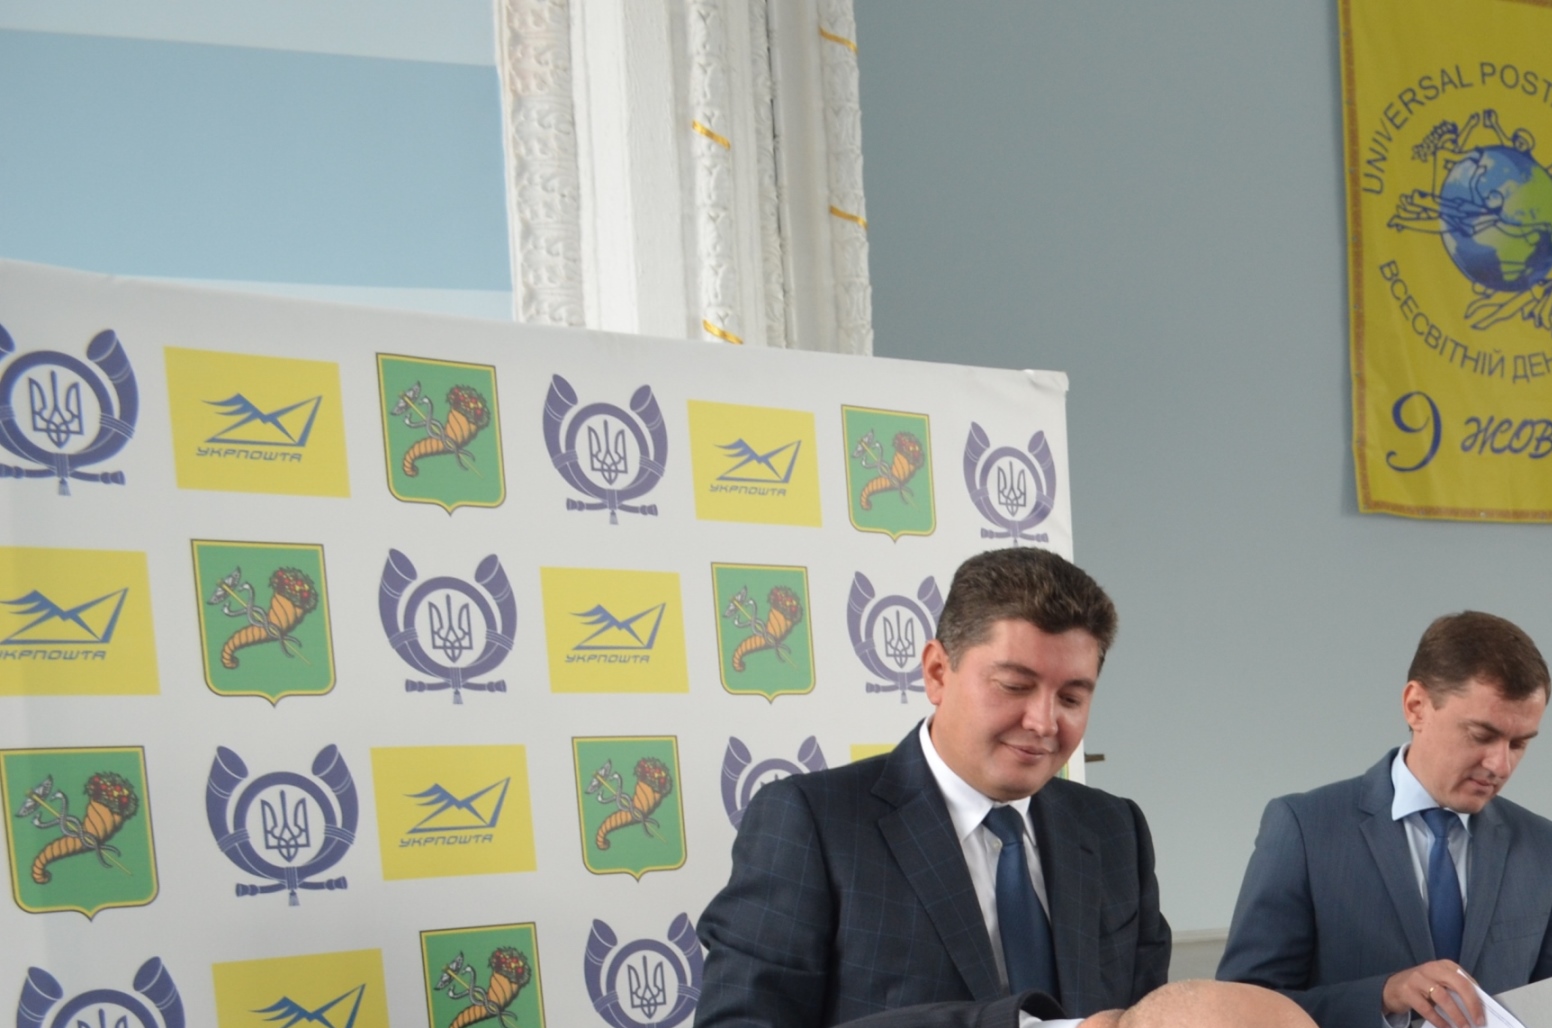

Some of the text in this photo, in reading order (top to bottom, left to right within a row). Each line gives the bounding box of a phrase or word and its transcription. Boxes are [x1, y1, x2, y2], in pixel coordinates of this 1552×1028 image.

[1362, 64, 1475, 195] UNIVERSAL
[1379, 259, 1505, 379] ВСЕСВІТНІЙ
[1386, 391, 1442, 473] 9
[196, 447, 303, 463] УКРПОШТА
[709, 484, 787, 497] УКРПОШТА
[0, 649, 107, 661] КРПОШТА
[564, 653, 650, 664] УКРПОШТА
[398, 833, 494, 848] УКРПОШТА
